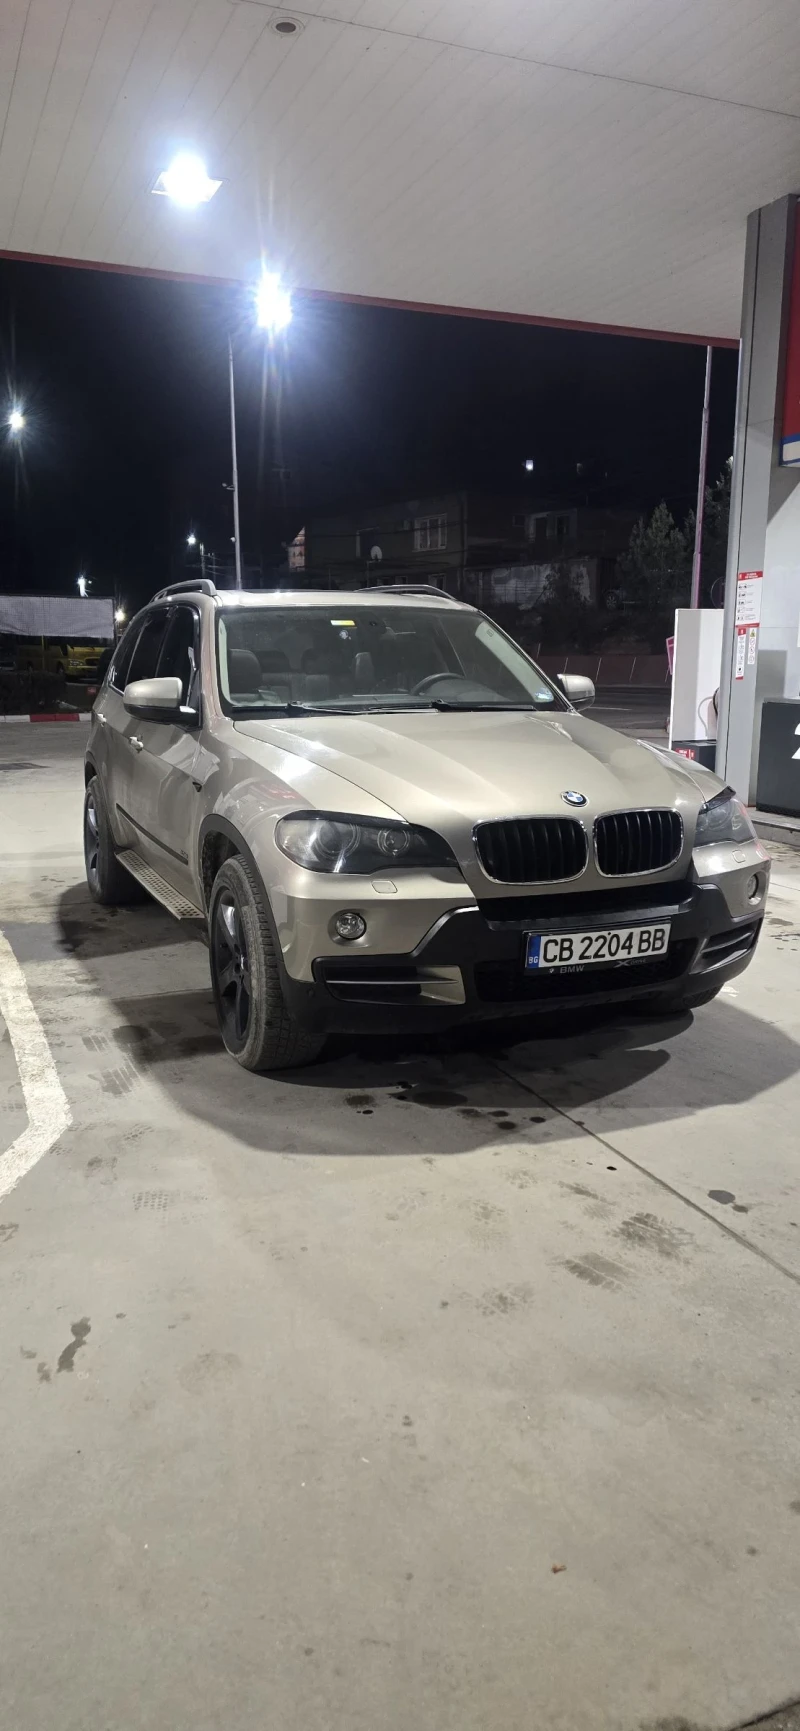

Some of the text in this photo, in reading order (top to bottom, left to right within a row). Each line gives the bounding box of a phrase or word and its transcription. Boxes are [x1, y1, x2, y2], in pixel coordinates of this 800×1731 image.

[543, 928, 666, 963] CB 2204 BB
[528, 956, 539, 964] BG
[559, 965, 585, 974] BMW
